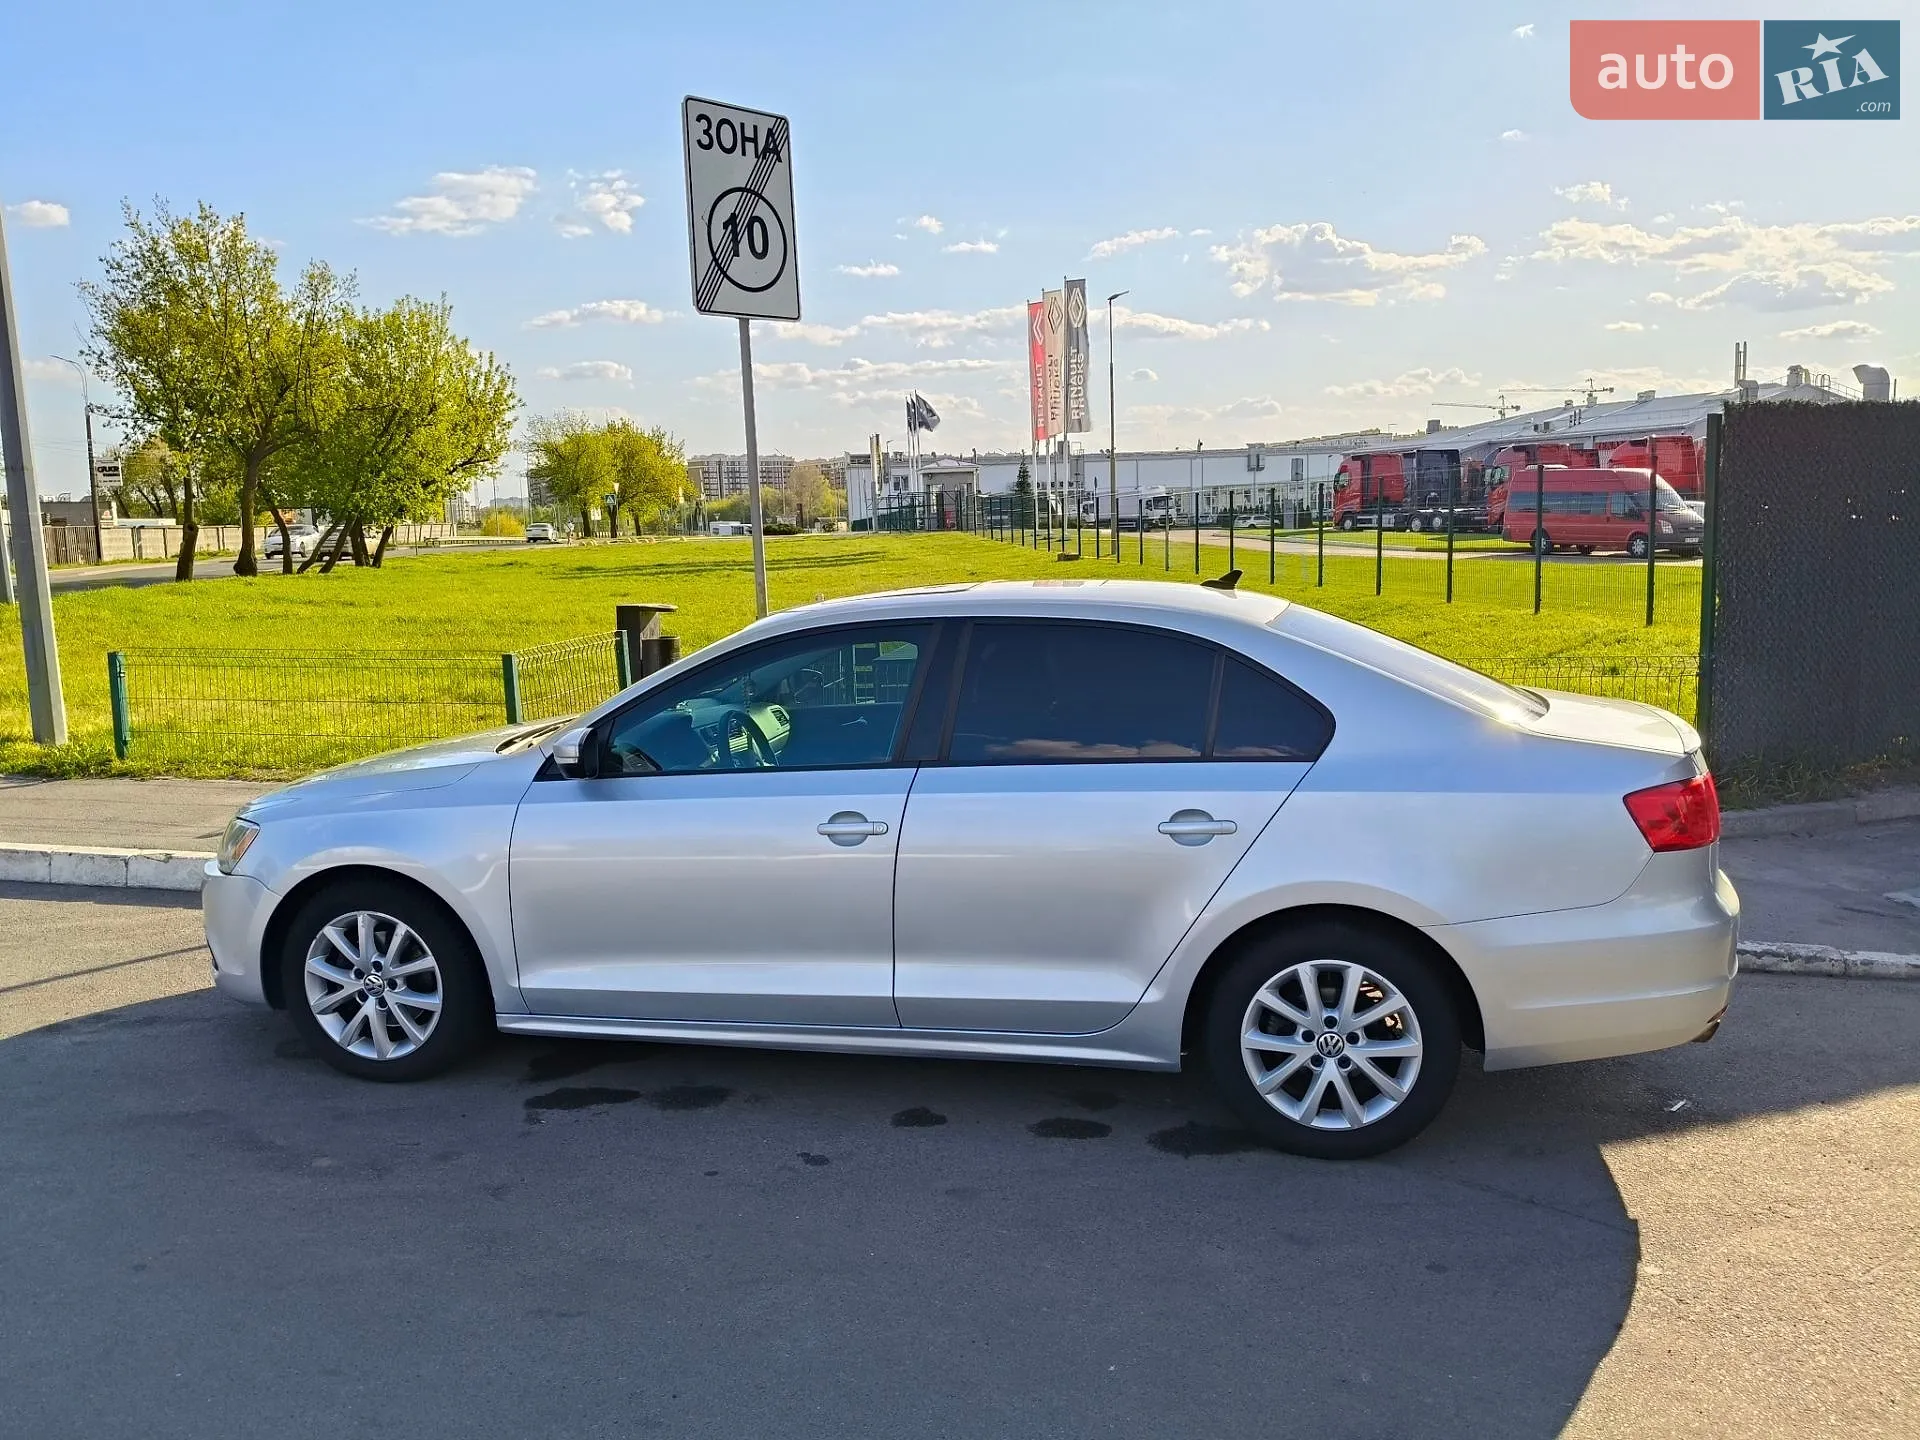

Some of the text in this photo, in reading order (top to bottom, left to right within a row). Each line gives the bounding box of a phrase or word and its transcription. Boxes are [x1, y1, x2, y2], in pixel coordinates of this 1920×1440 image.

[695, 113, 783, 163] ЗОНА
[722, 212, 770, 261] 10
[1035, 361, 1045, 428] RENAULT
[1070, 346, 1081, 420] RENAULT
[1077, 352, 1086, 417] TRUCKS
